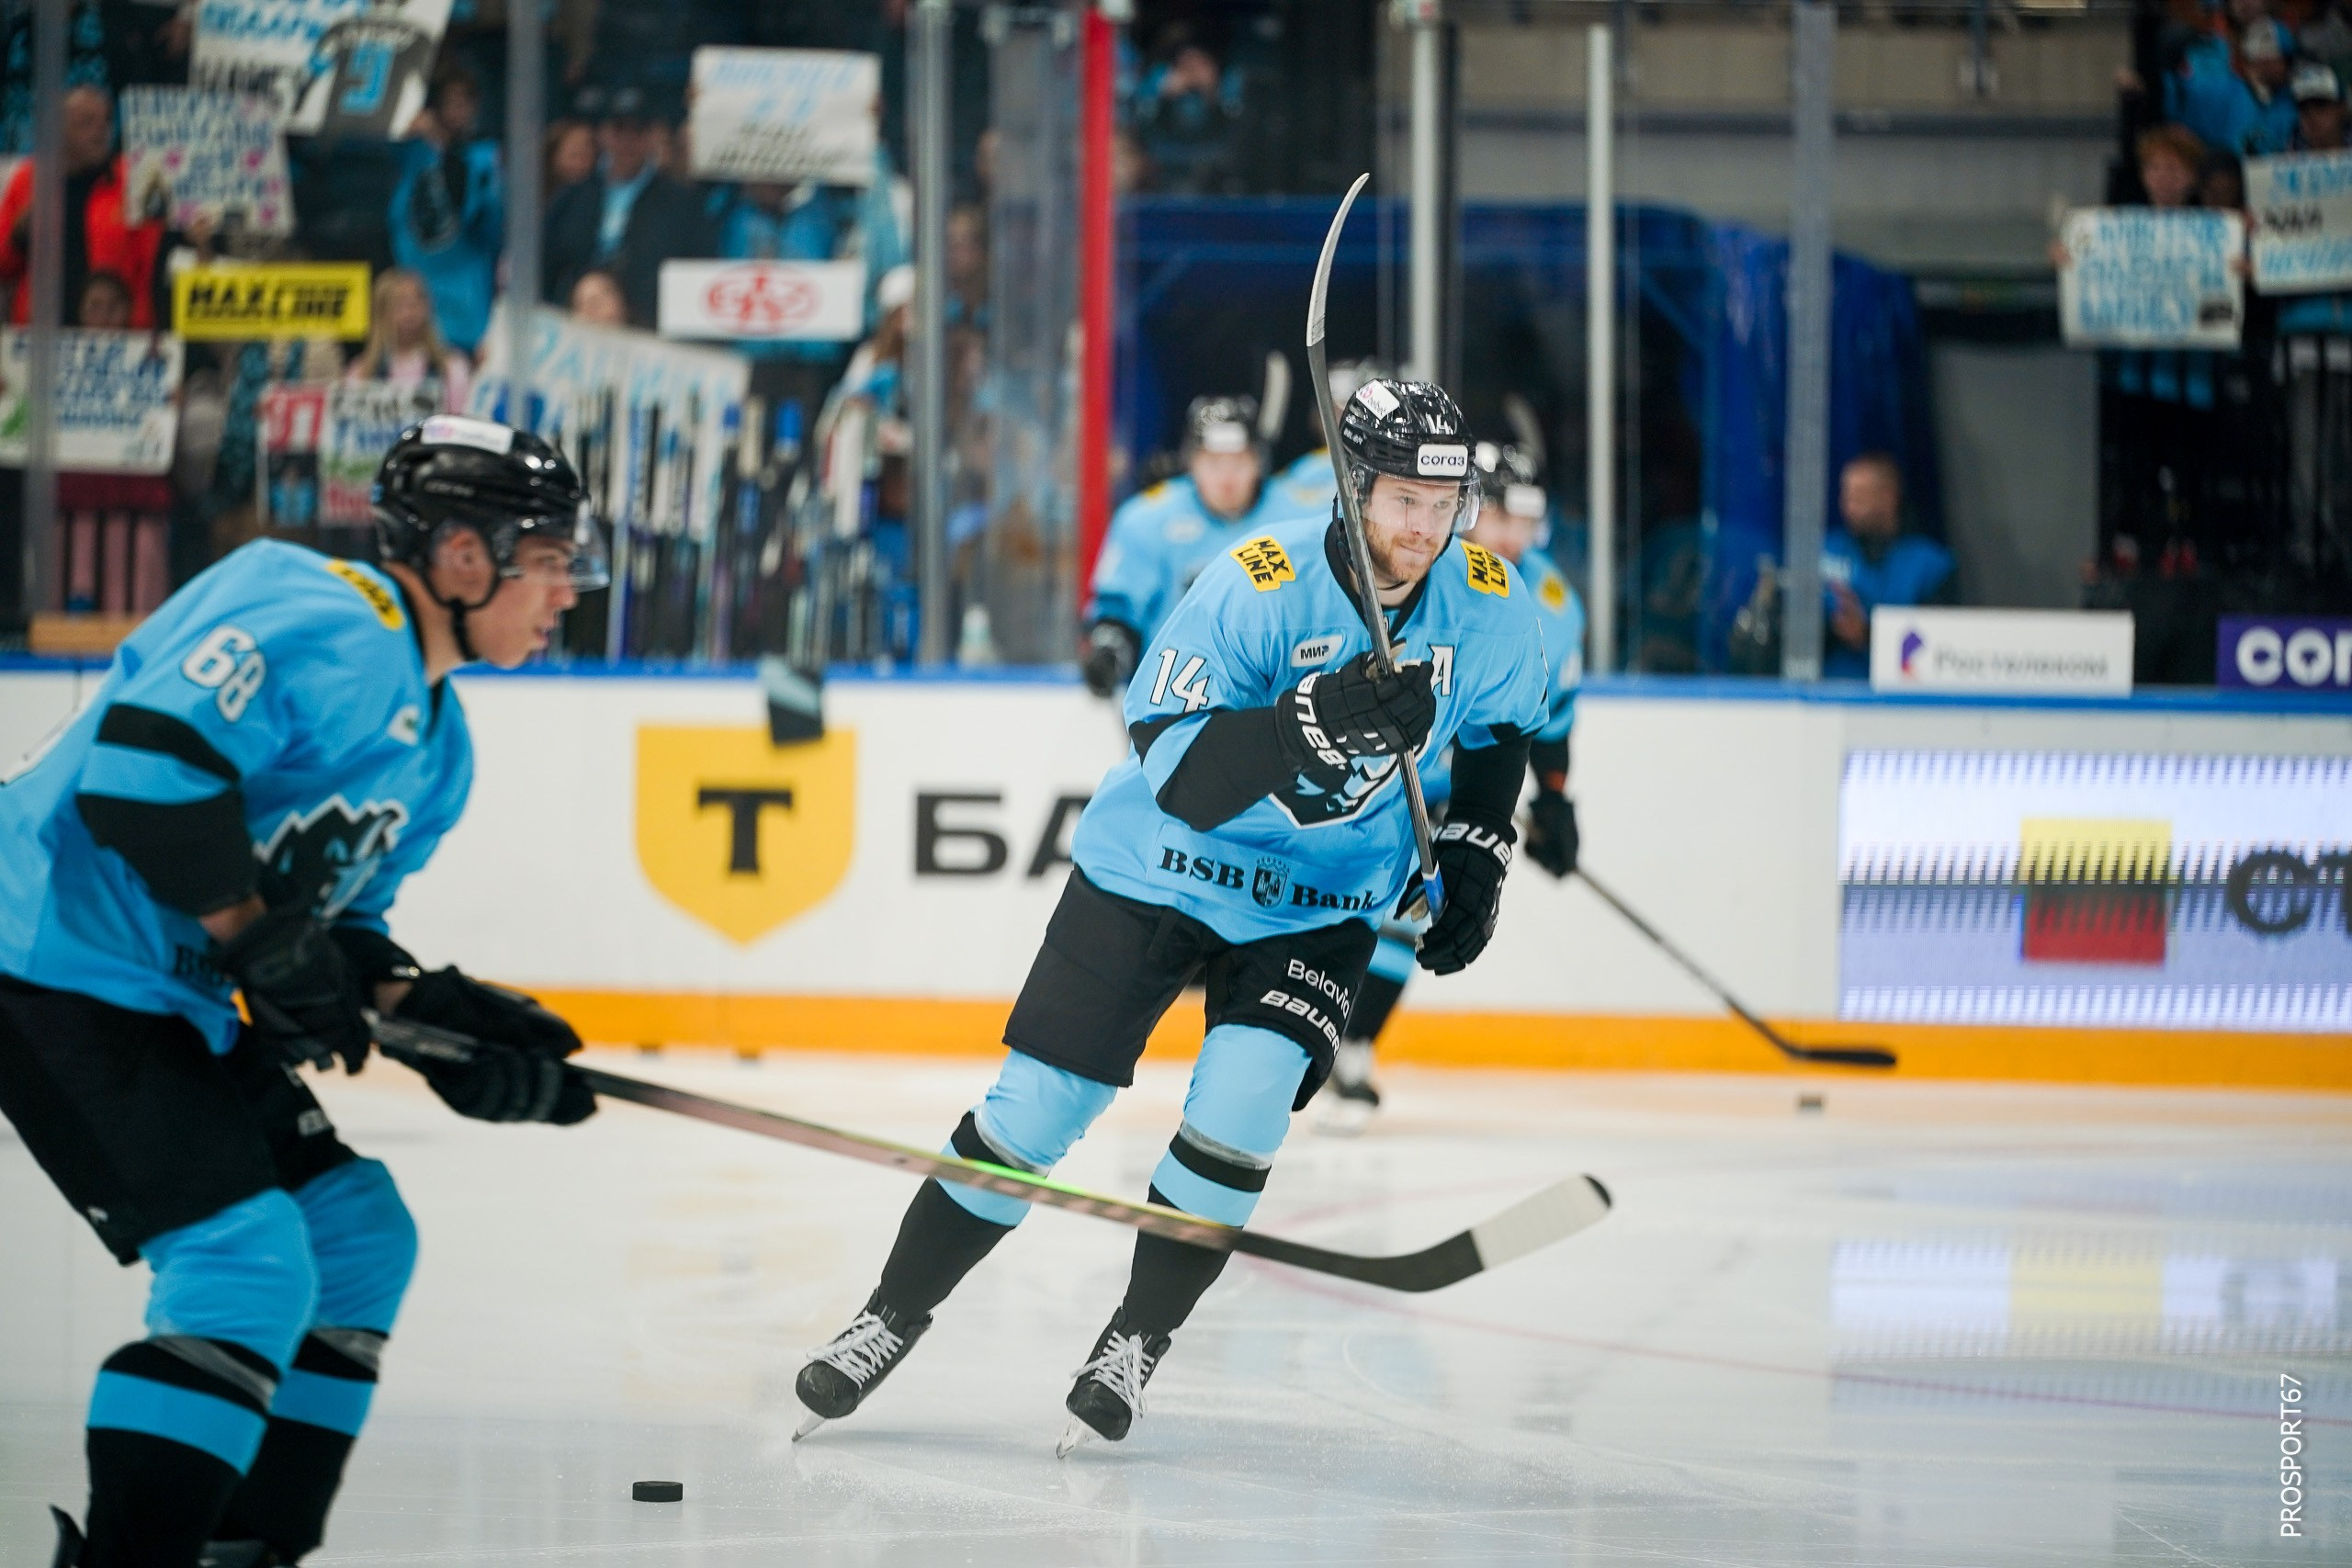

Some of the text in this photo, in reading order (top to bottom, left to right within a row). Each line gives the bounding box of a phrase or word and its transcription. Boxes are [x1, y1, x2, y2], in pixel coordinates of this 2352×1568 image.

[1237, 547, 1273, 584] LINE
[1253, 539, 1290, 574] MAX
[1466, 547, 1488, 585] MAX
[181, 625, 266, 724] 68
[1149, 648, 1211, 713] 14
[1430, 645, 1454, 696] A
[1157, 845, 1377, 911] BSB Bank
[1287, 958, 1350, 1020] Belavia
